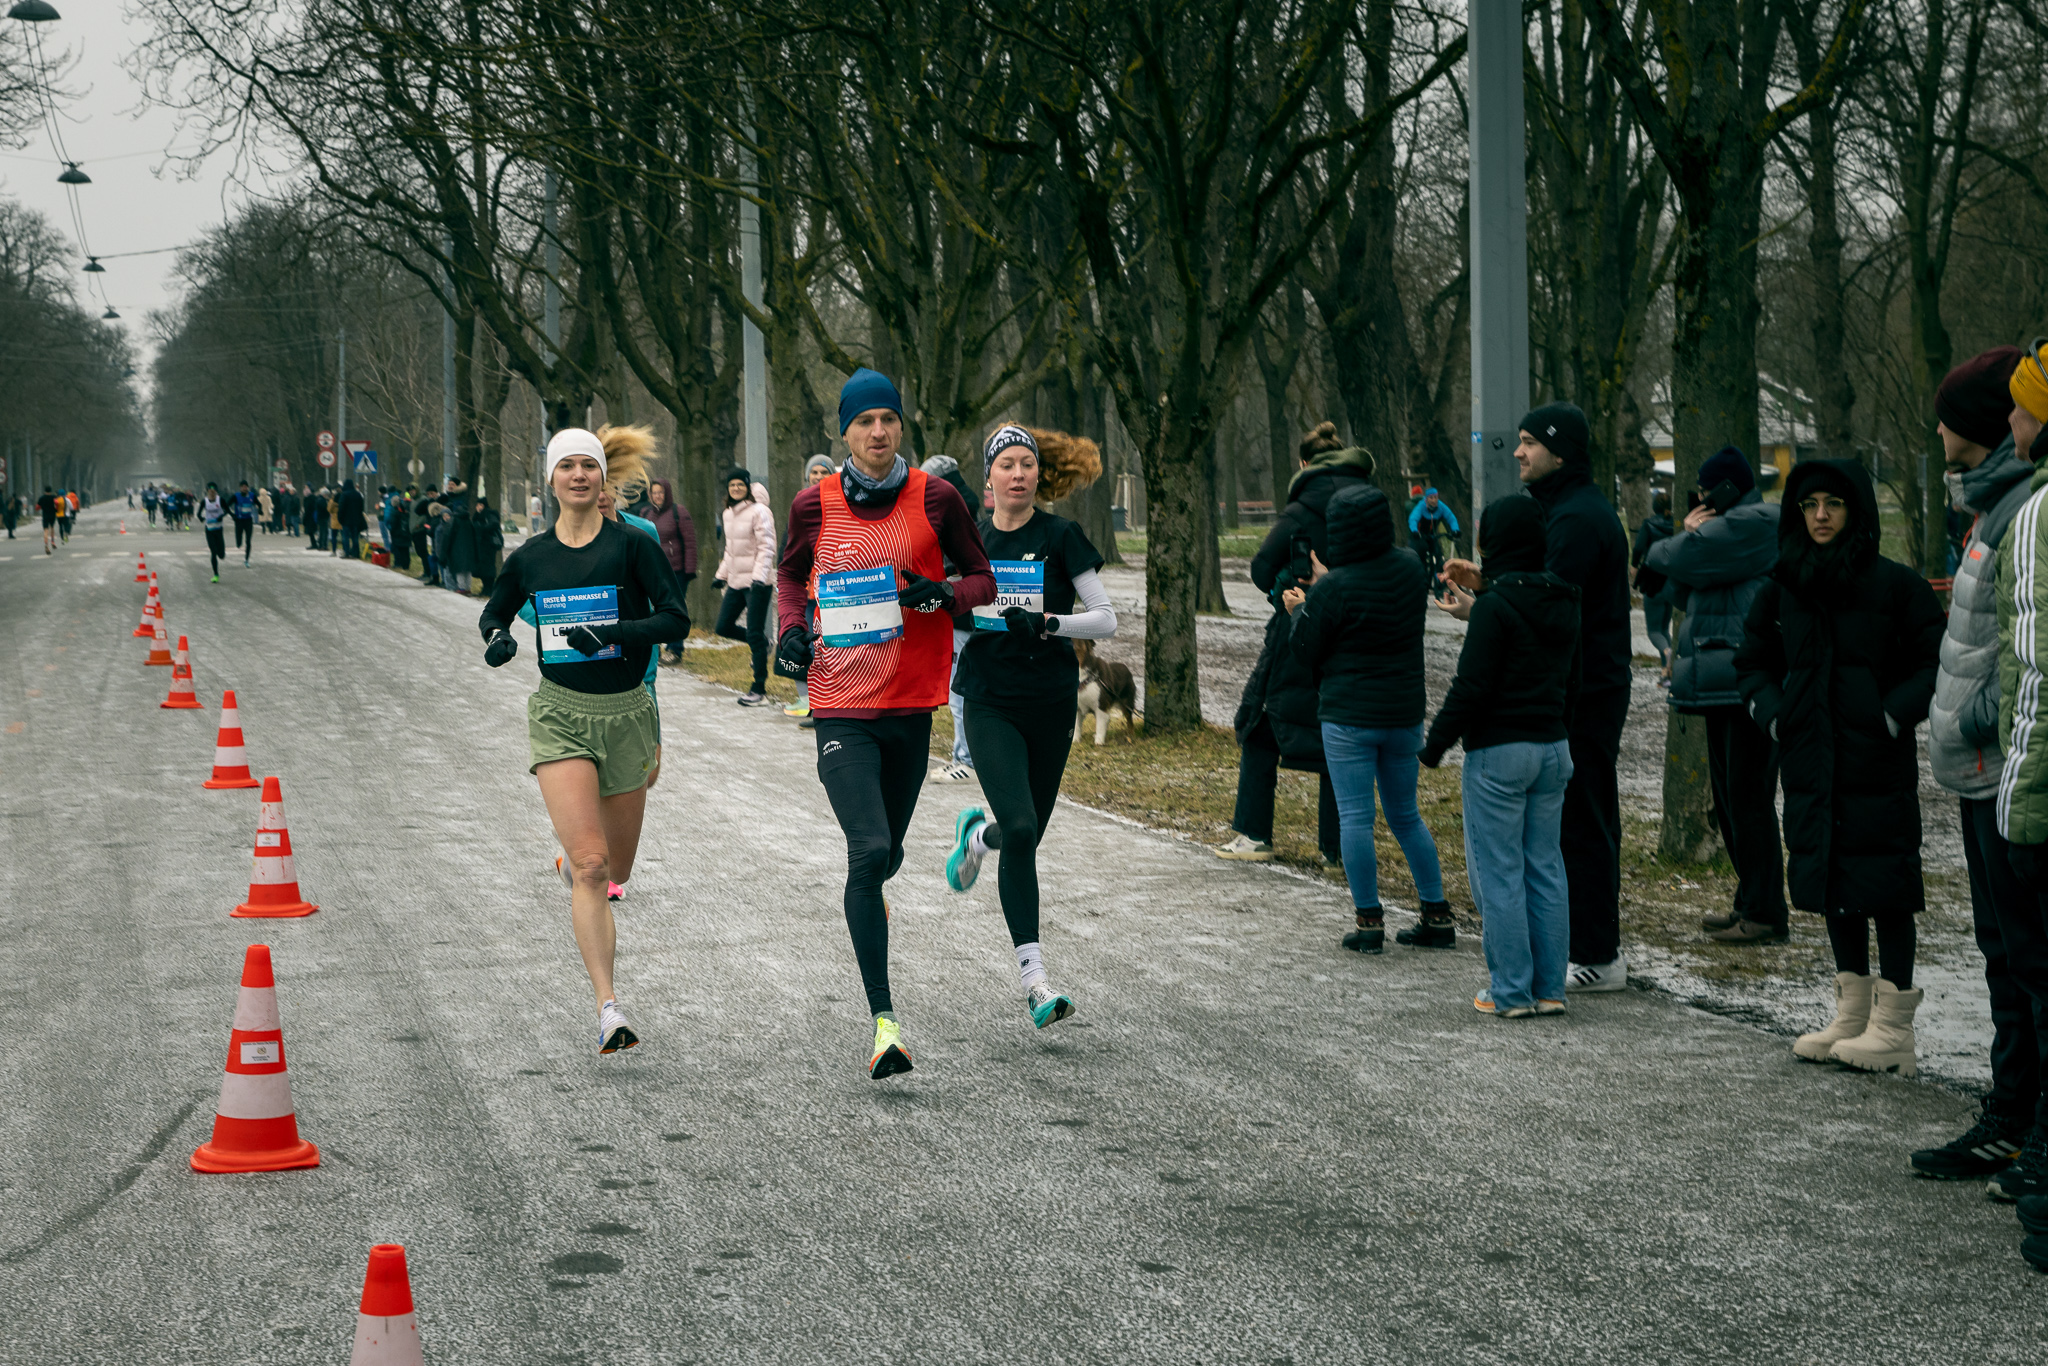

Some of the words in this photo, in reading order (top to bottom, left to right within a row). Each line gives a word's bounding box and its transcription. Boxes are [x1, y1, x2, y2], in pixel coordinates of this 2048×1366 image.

[846, 574, 879, 585] SPARKASSE
[543, 596, 560, 604] ERSTE
[567, 593, 602, 602] SPARKASSE
[852, 622, 868, 630] 717
